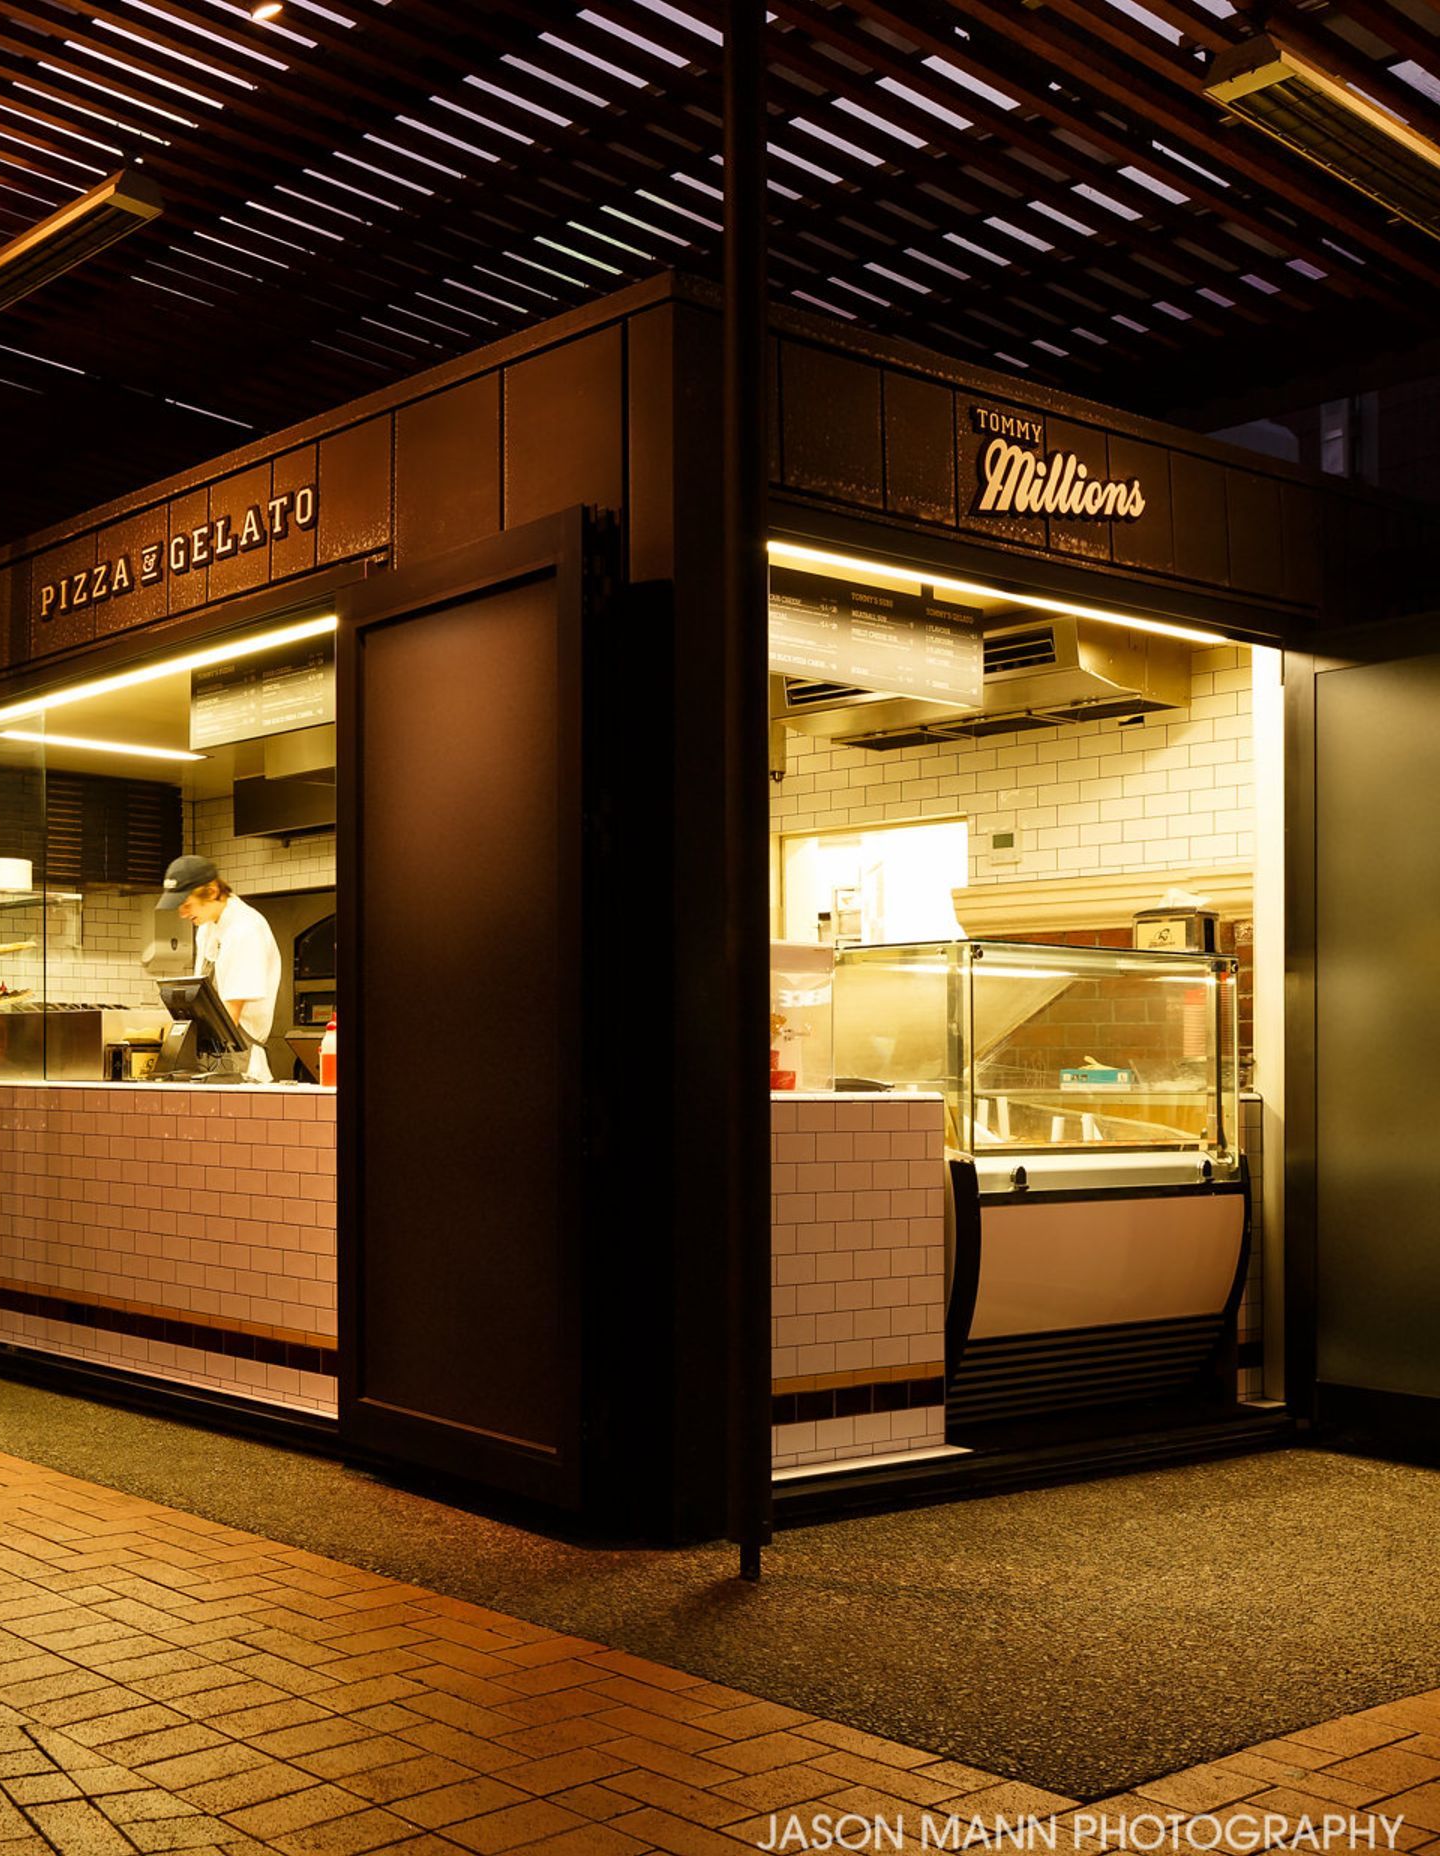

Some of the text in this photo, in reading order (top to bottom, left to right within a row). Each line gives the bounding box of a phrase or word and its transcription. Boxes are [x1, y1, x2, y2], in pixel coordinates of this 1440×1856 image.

[976, 408, 1043, 443] TOMMY
[978, 437, 1146, 517] Millions
[40, 487, 314, 617] PIZZA & GELATO
